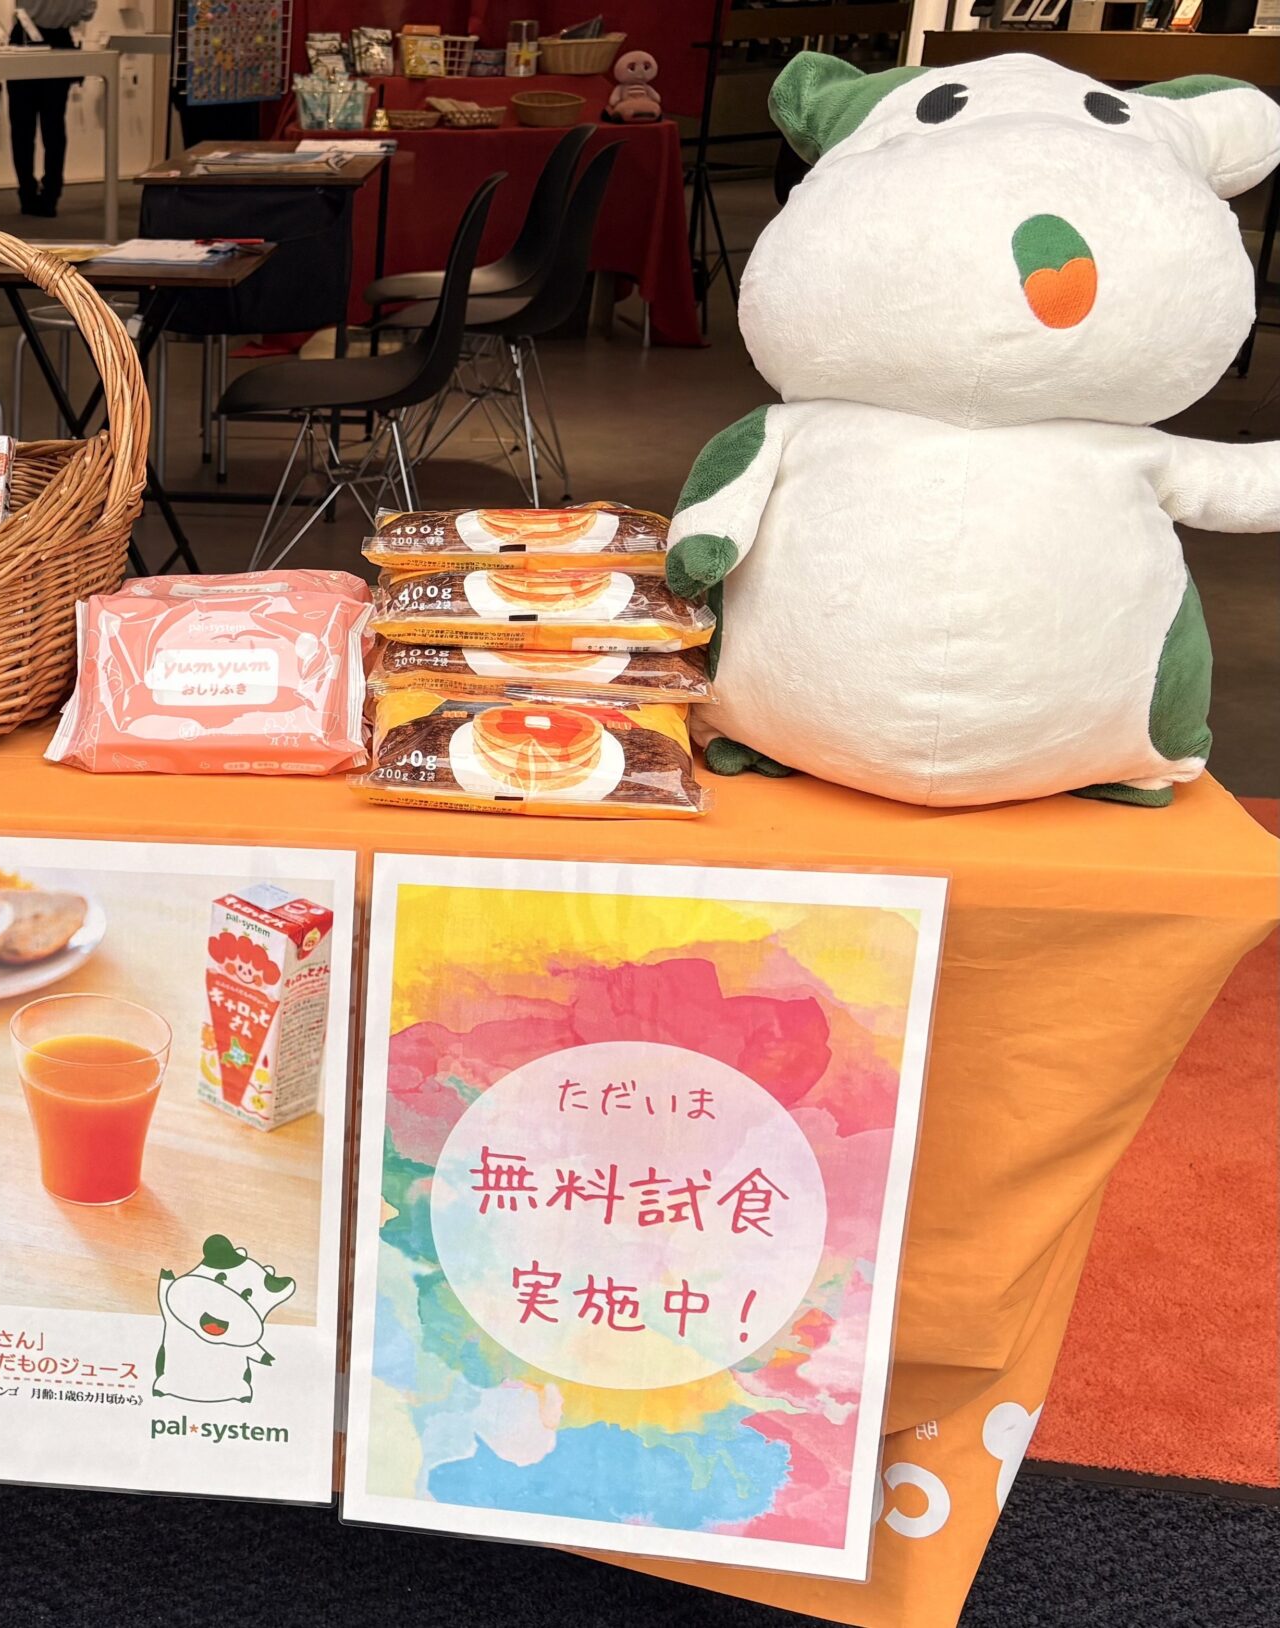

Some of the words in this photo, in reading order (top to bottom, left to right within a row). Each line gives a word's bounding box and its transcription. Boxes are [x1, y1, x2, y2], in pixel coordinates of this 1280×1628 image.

[182, 683, 247, 696] おしりふき
[208, 987, 271, 1028] キャロっと
[229, 1014, 253, 1039] さん
[558, 1078, 717, 1121] ただいま
[469, 1145, 791, 1238] 無料試食
